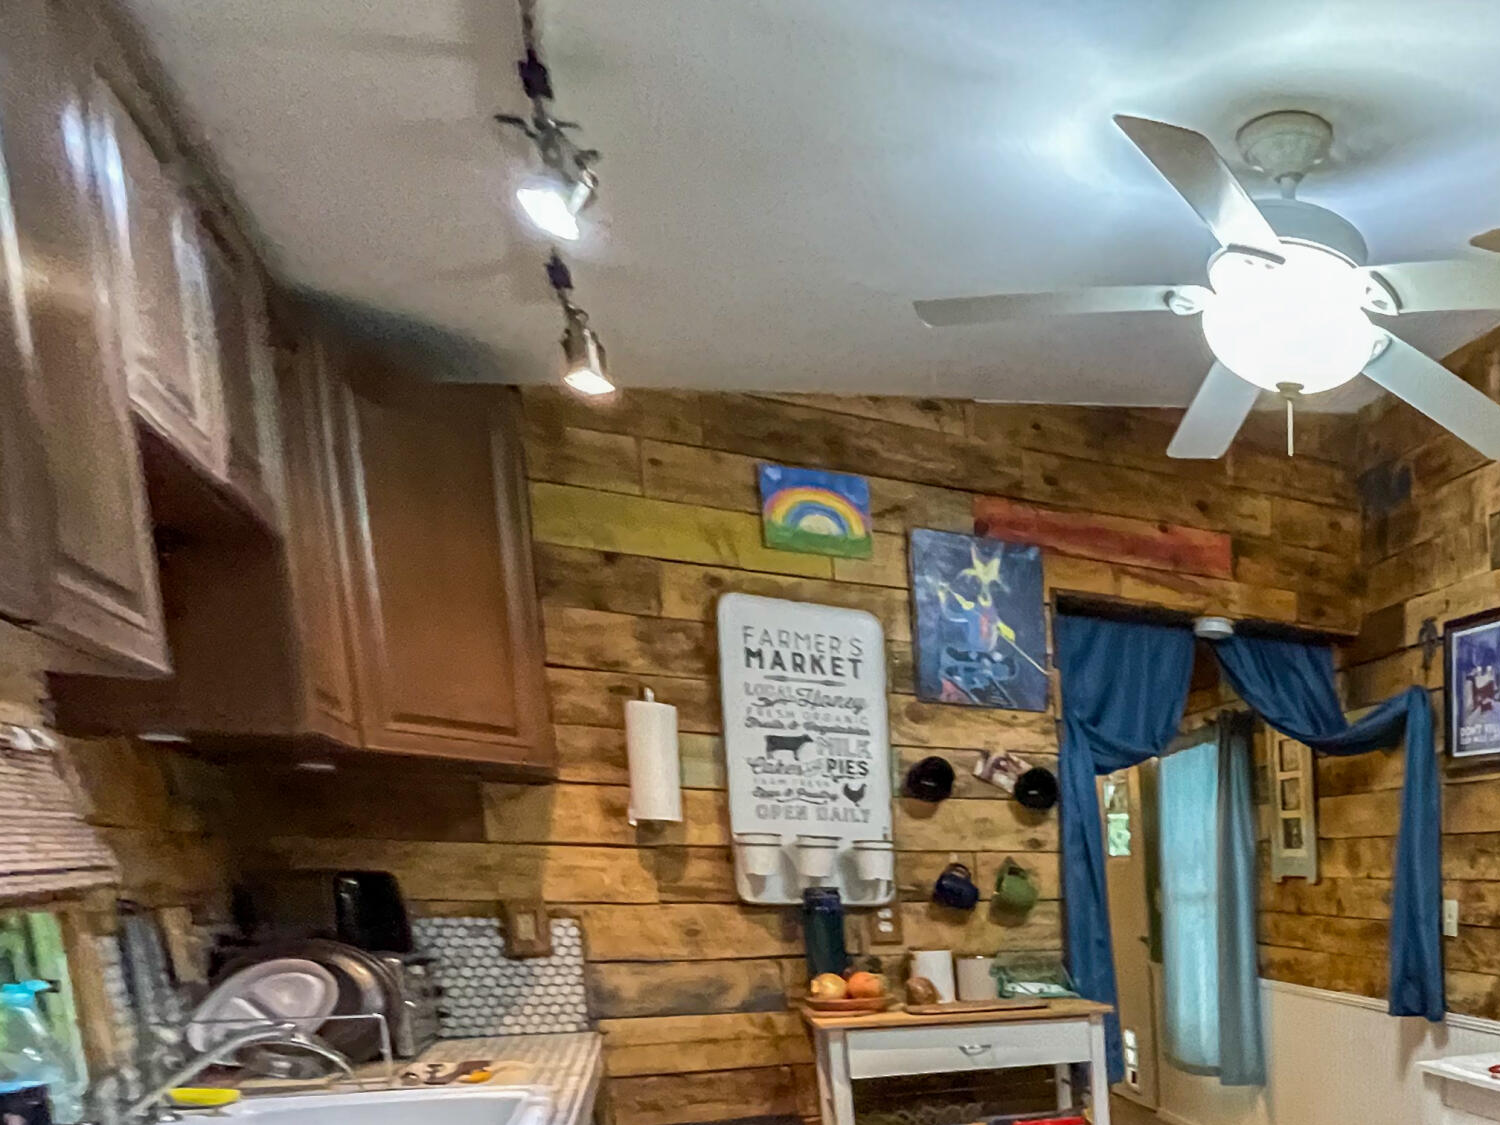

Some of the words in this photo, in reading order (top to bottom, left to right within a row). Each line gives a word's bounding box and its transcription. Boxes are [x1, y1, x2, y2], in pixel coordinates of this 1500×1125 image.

[743, 646, 863, 679] MARKET
[826, 758, 870, 777] PIES
[755, 803, 809, 821] OPEN
